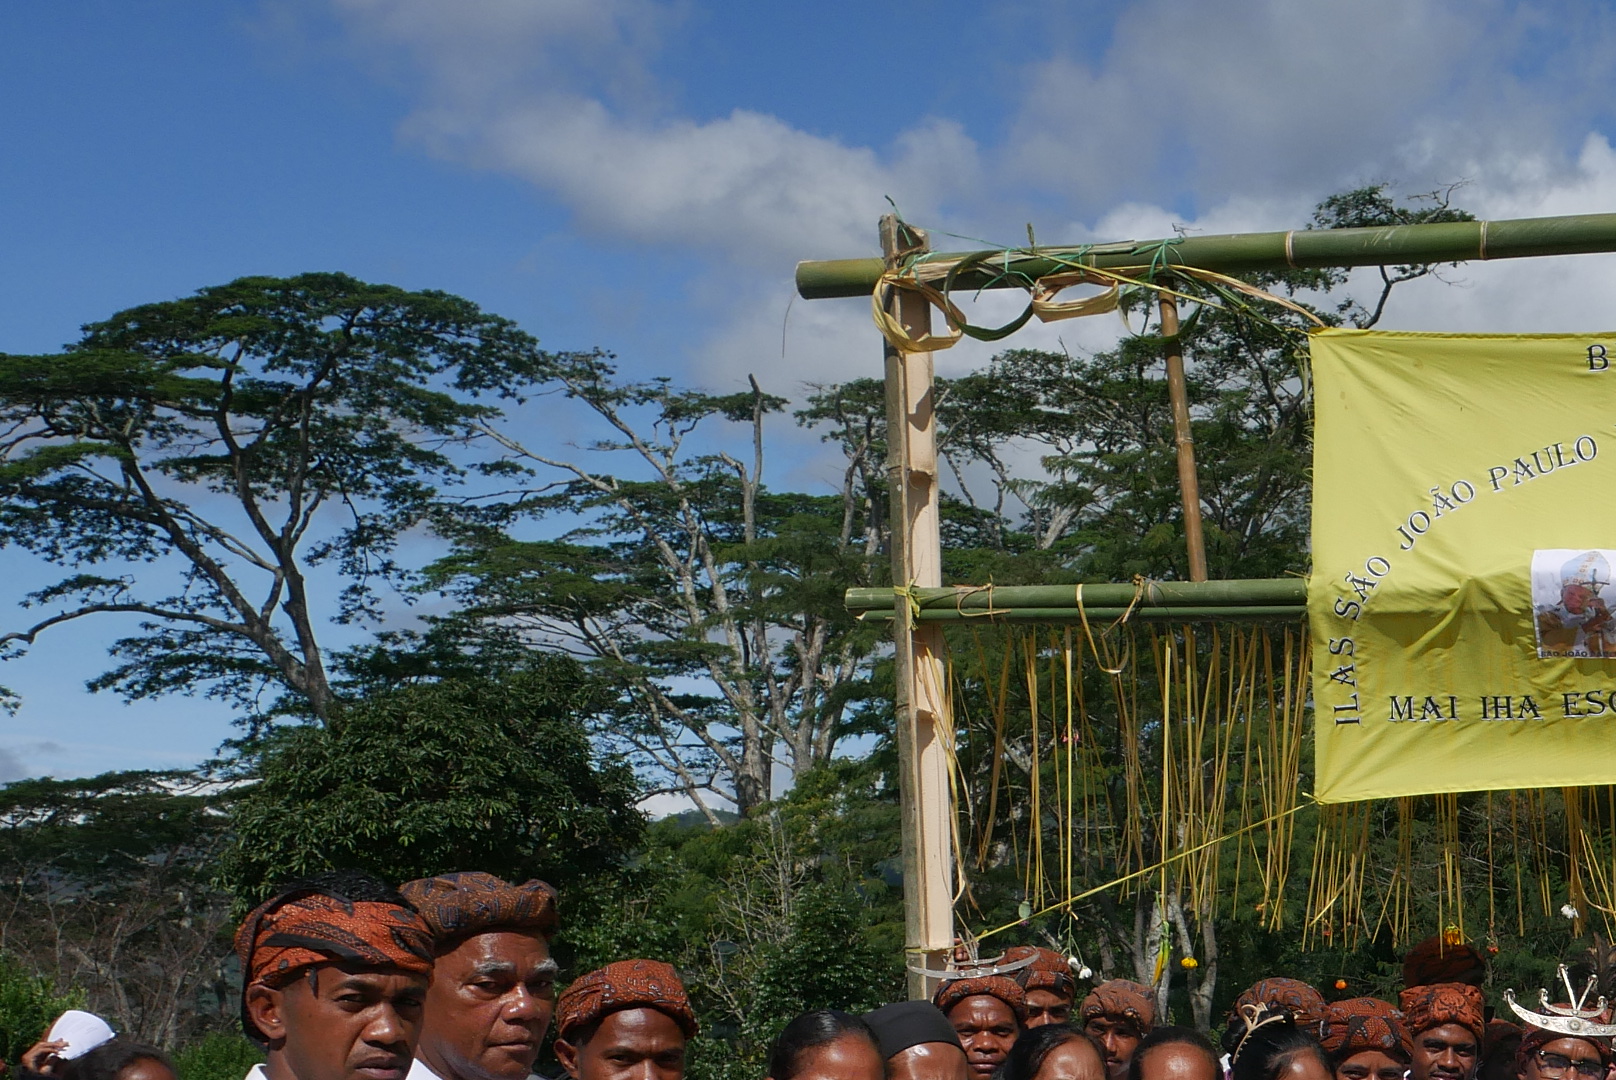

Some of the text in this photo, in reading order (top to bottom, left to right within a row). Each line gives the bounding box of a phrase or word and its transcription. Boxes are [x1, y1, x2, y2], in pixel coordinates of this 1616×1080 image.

[1488, 435, 1598, 492] PAULO
[1397, 479, 1476, 551] JOÃO
[1334, 556, 1391, 622] SÃO
[1330, 637, 1361, 727] ILAS
[1388, 695, 1459, 722] MAI
[1480, 695, 1543, 721] IHA
